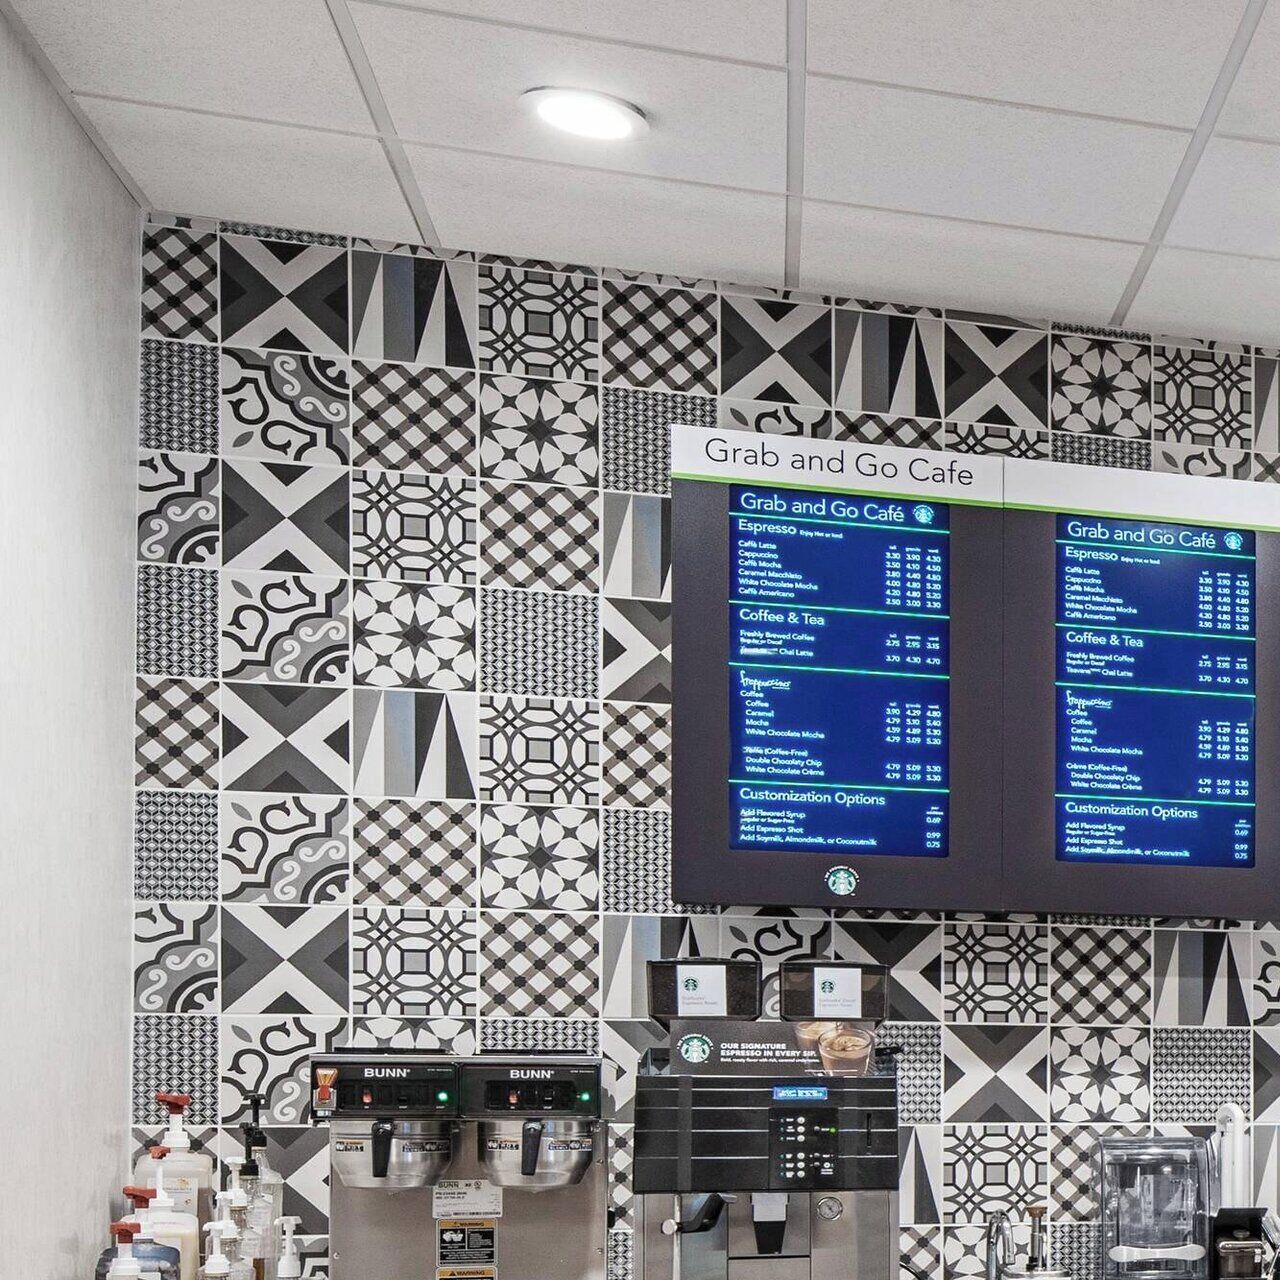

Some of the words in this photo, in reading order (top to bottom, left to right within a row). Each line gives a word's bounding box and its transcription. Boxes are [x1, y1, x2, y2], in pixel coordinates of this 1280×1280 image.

[706, 438, 779, 467] Grab
[791, 449, 844, 474] and
[856, 453, 898, 478] Go
[909, 458, 973, 485] Cafe
[741, 493, 786, 512] Grab
[792, 500, 826, 516] and
[831, 502, 858, 518] Go
[864, 504, 904, 522] Café
[739, 519, 797, 535] Espresso
[1068, 521, 1109, 539] Grab
[1114, 528, 1144, 542] and
[1150, 529, 1174, 545] Go
[1179, 531, 1216, 548] Café
[759, 541, 776, 550] Latte
[739, 550, 778, 560] Cappuccino
[1066, 547, 1118, 561] Espresso
[759, 560, 781, 569] Mocha
[739, 568, 766, 577] Caramel
[760, 579, 793, 588] Chocolate
[795, 582, 818, 590] Mocha
[759, 589, 794, 598] Americano
[906, 600, 920, 608] 3.00
[740, 609, 784, 622] Coffee
[788, 612, 799, 624] &
[802, 614, 824, 626] Tea
[740, 630, 764, 639] Freshly
[765, 632, 791, 640] Brewed
[792, 634, 814, 642] Coffee
[1066, 632, 1106, 645] Coffee
[1110, 635, 1120, 646] &
[1123, 636, 1144, 648] Tea
[740, 690, 764, 698] Coffee
[746, 710, 774, 718] Caramel
[746, 719, 769, 727] Mocha
[746, 728, 766, 736] White
[767, 729, 800, 738] Chocolate
[746, 757, 770, 765] Double
[806, 759, 822, 767] Chip
[746, 766, 766, 774] White
[767, 767, 800, 775] Chocolate
[740, 788, 831, 803] Customization
[835, 792, 885, 807] Options
[786, 811, 805, 820] Syrup
[1065, 802, 1148, 816] Customization
[1152, 806, 1198, 820] Options
[757, 826, 786, 834] Espresso
[364, 1069, 407, 1077] BUNN
[510, 1070, 551, 1079] BUNN
